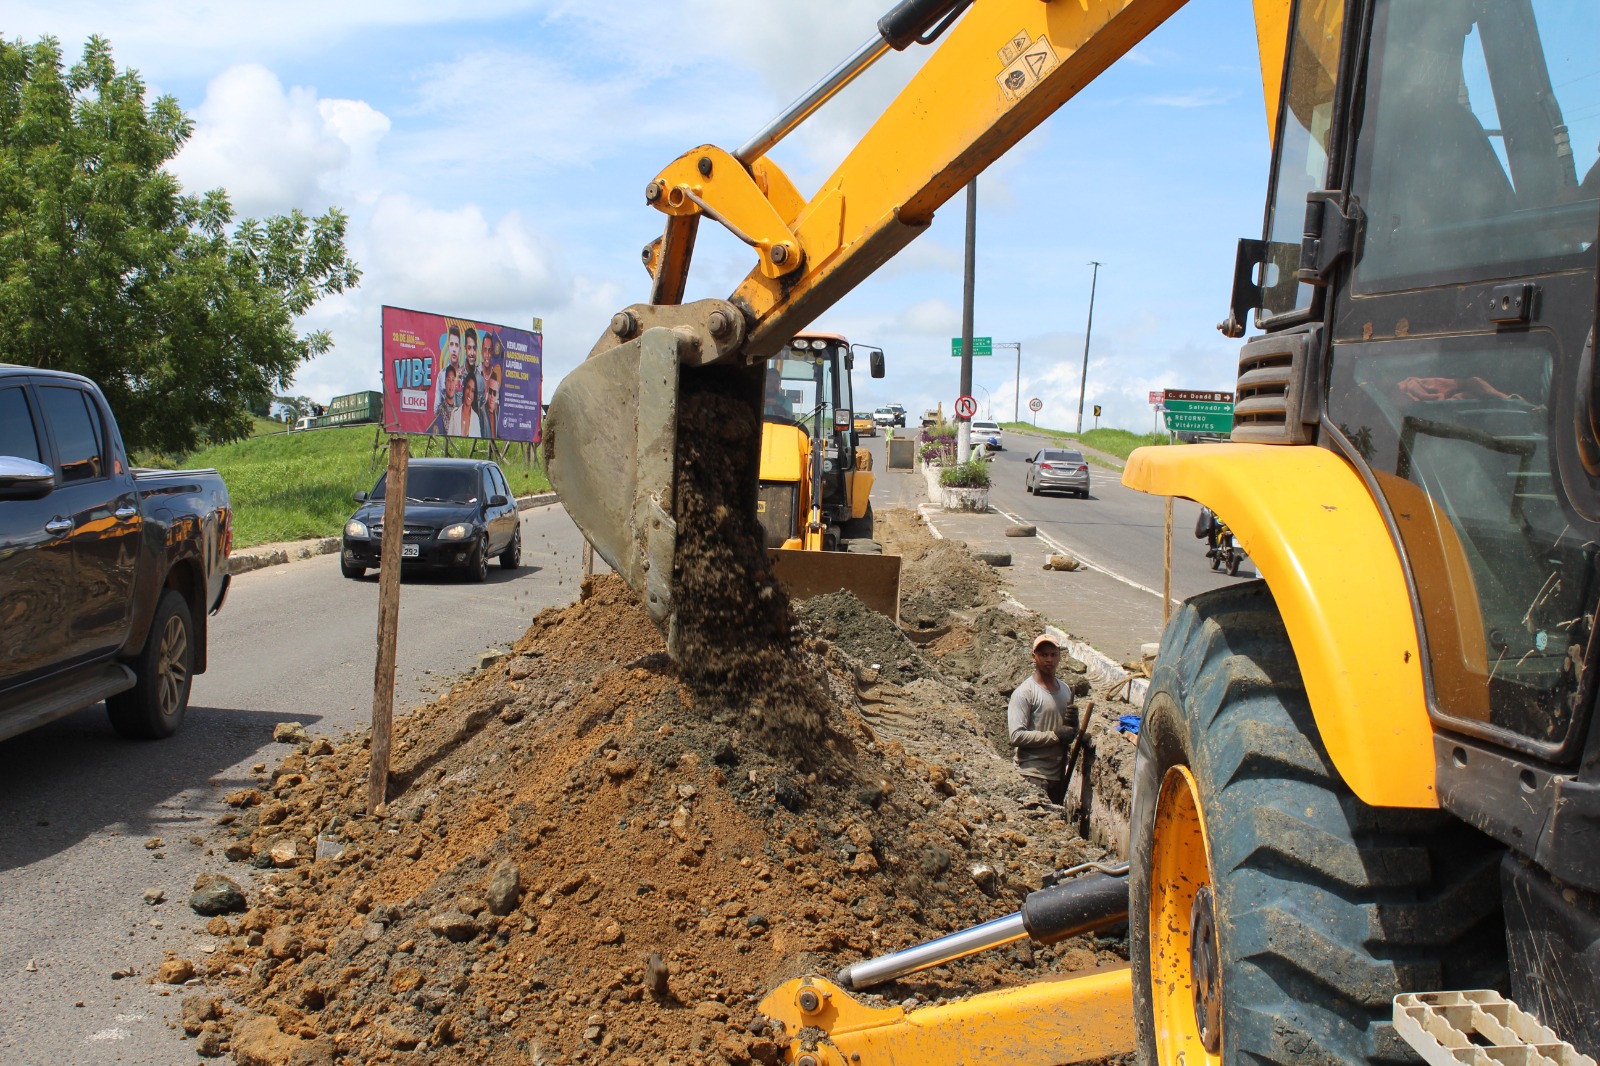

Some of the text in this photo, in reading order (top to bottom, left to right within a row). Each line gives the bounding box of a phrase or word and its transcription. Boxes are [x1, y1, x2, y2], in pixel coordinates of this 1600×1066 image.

[394, 356, 433, 389] VIBE
[403, 396, 426, 407] LOKA
[1174, 422, 1215, 430] Vitória/ES
